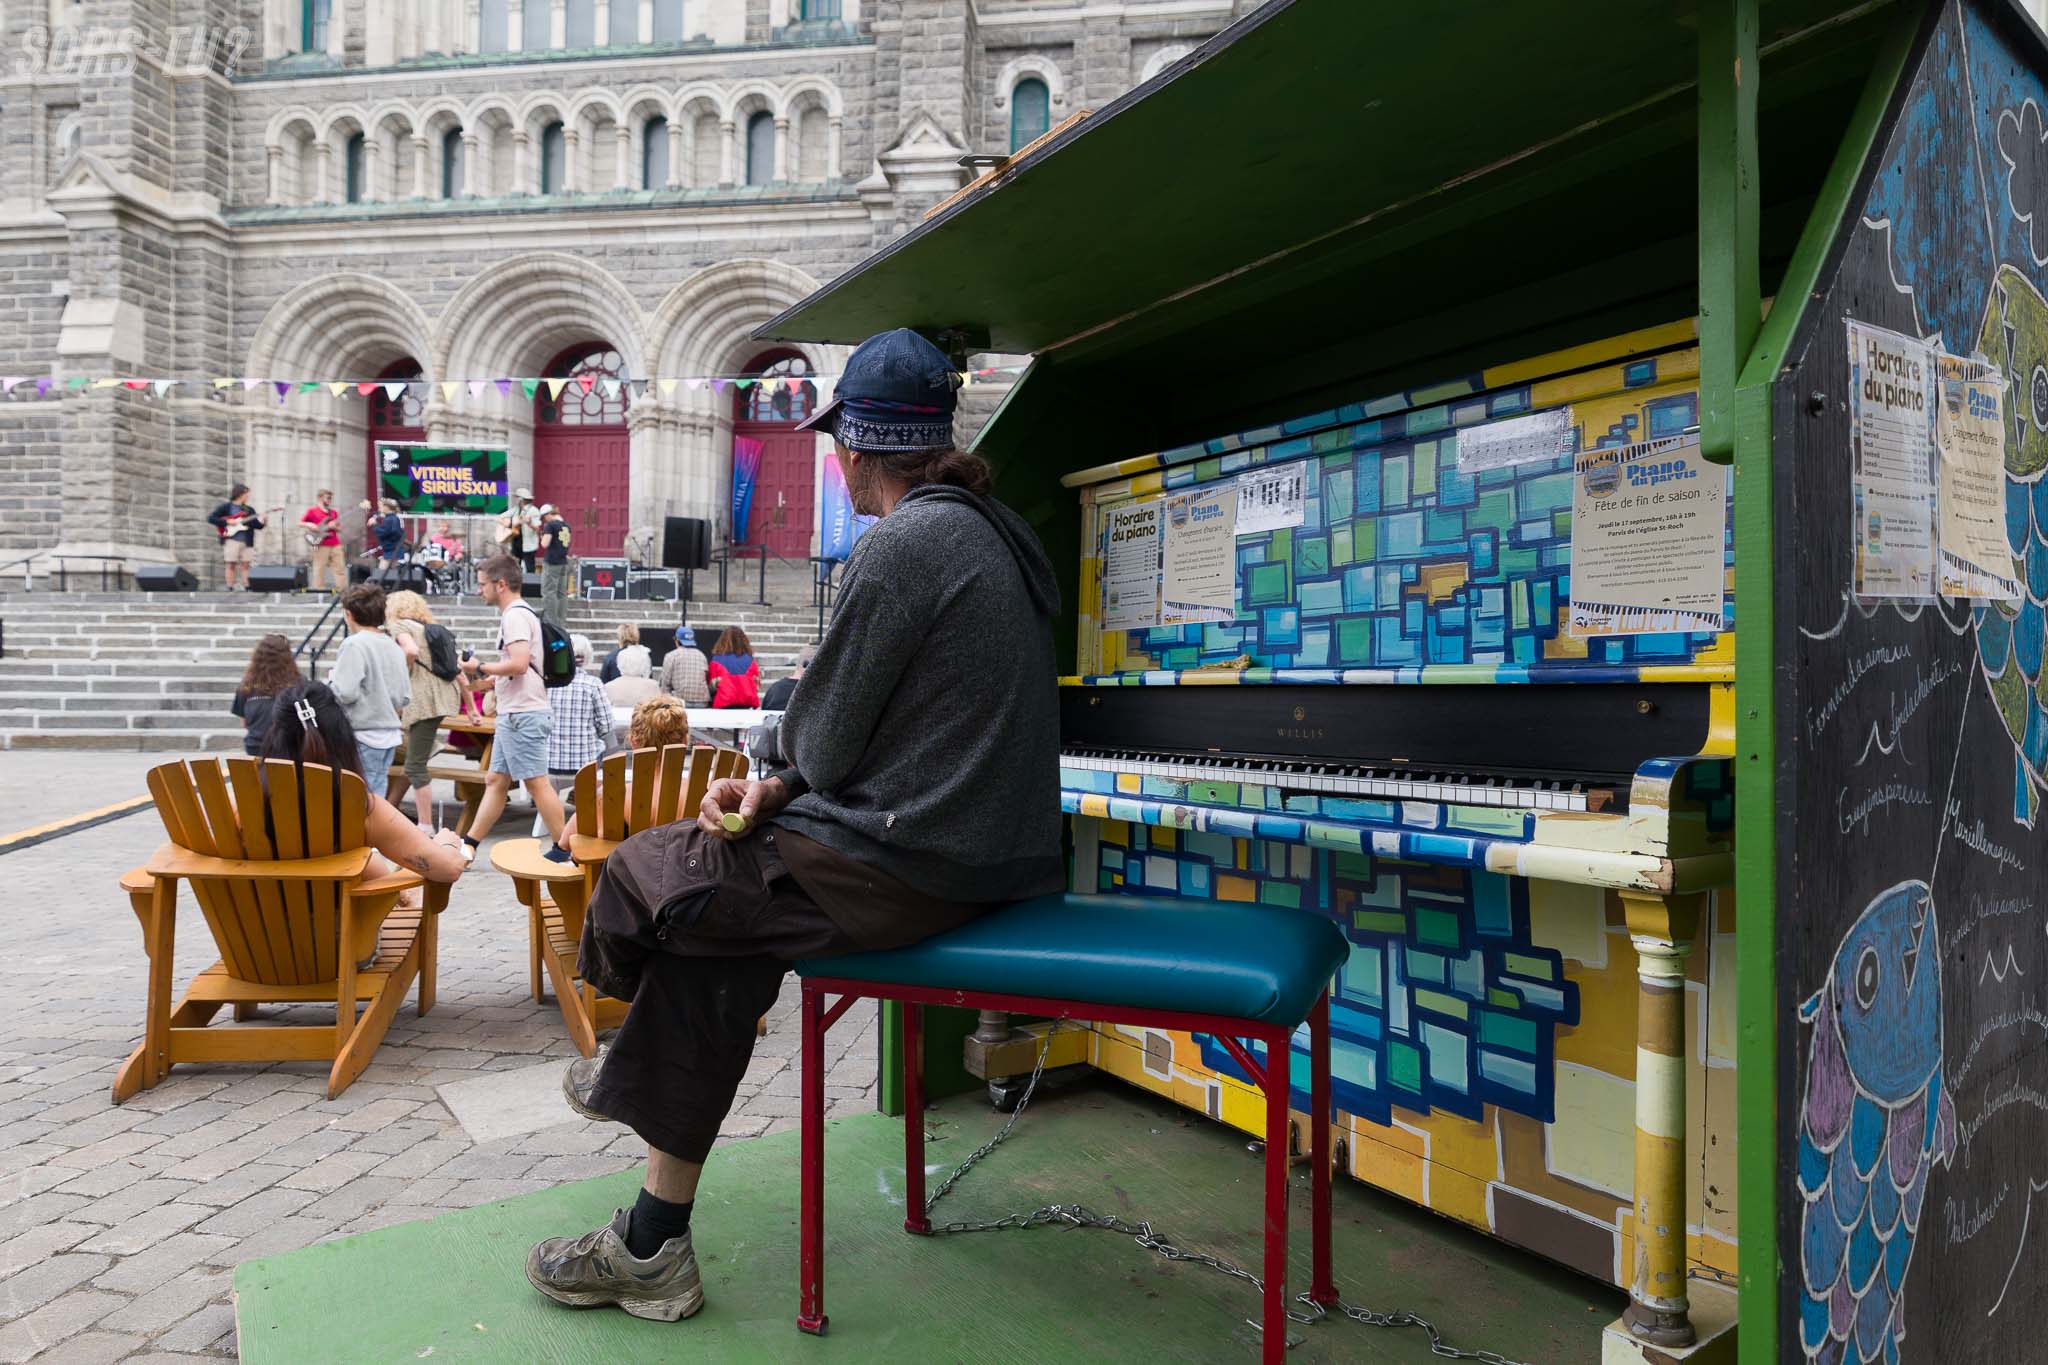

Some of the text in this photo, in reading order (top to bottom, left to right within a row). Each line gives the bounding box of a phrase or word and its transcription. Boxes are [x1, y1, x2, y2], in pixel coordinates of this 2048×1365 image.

[1866, 339, 1920, 381] Horaire
[1864, 370, 1924, 411] du piano
[1968, 387, 1997, 410] Piano
[411, 466, 473, 481] VITRINE
[1626, 460, 1686, 480] Piano
[1632, 470, 1697, 486] du parvis
[421, 481, 497, 495] SIRIUSXM
[1594, 489, 1700, 512] Fête de fin de saison
[1114, 509, 1154, 528] Horaire
[1191, 504, 1219, 517] Piano
[1629, 516, 1665, 526] septembre,
[1112, 525, 1156, 542] du piano
[1636, 526, 1658, 534] l'église
[1276, 727, 1325, 738] WILLIS
